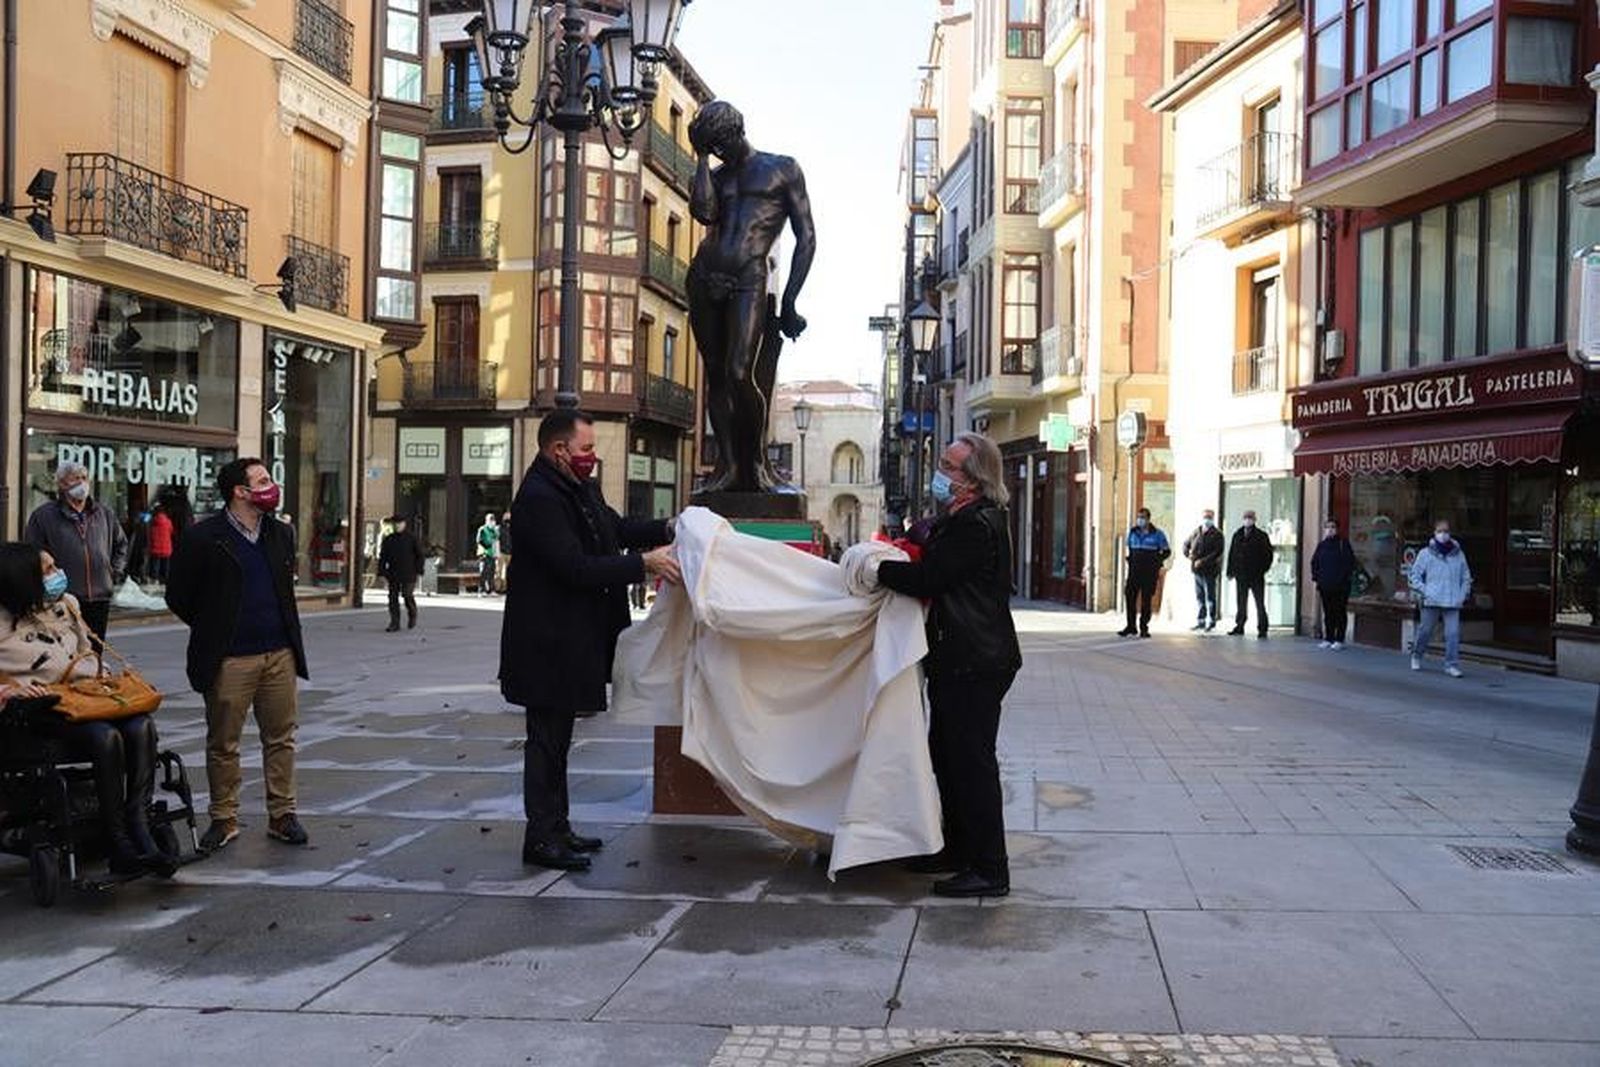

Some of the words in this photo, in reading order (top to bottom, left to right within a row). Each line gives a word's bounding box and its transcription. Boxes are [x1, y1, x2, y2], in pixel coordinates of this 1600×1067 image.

[82, 367, 198, 415] REBAJAS
[274, 340, 287, 394] SE
[1297, 398, 1352, 417] PANADERIA
[1363, 374, 1474, 416] TRIGAL
[1486, 368, 1574, 394] PASTELERIA
[58, 443, 115, 483] POR
[127, 446, 214, 488] CIERRE
[1333, 450, 1399, 470] PASTELERIA
[1411, 441, 1496, 465] PANADERIA
